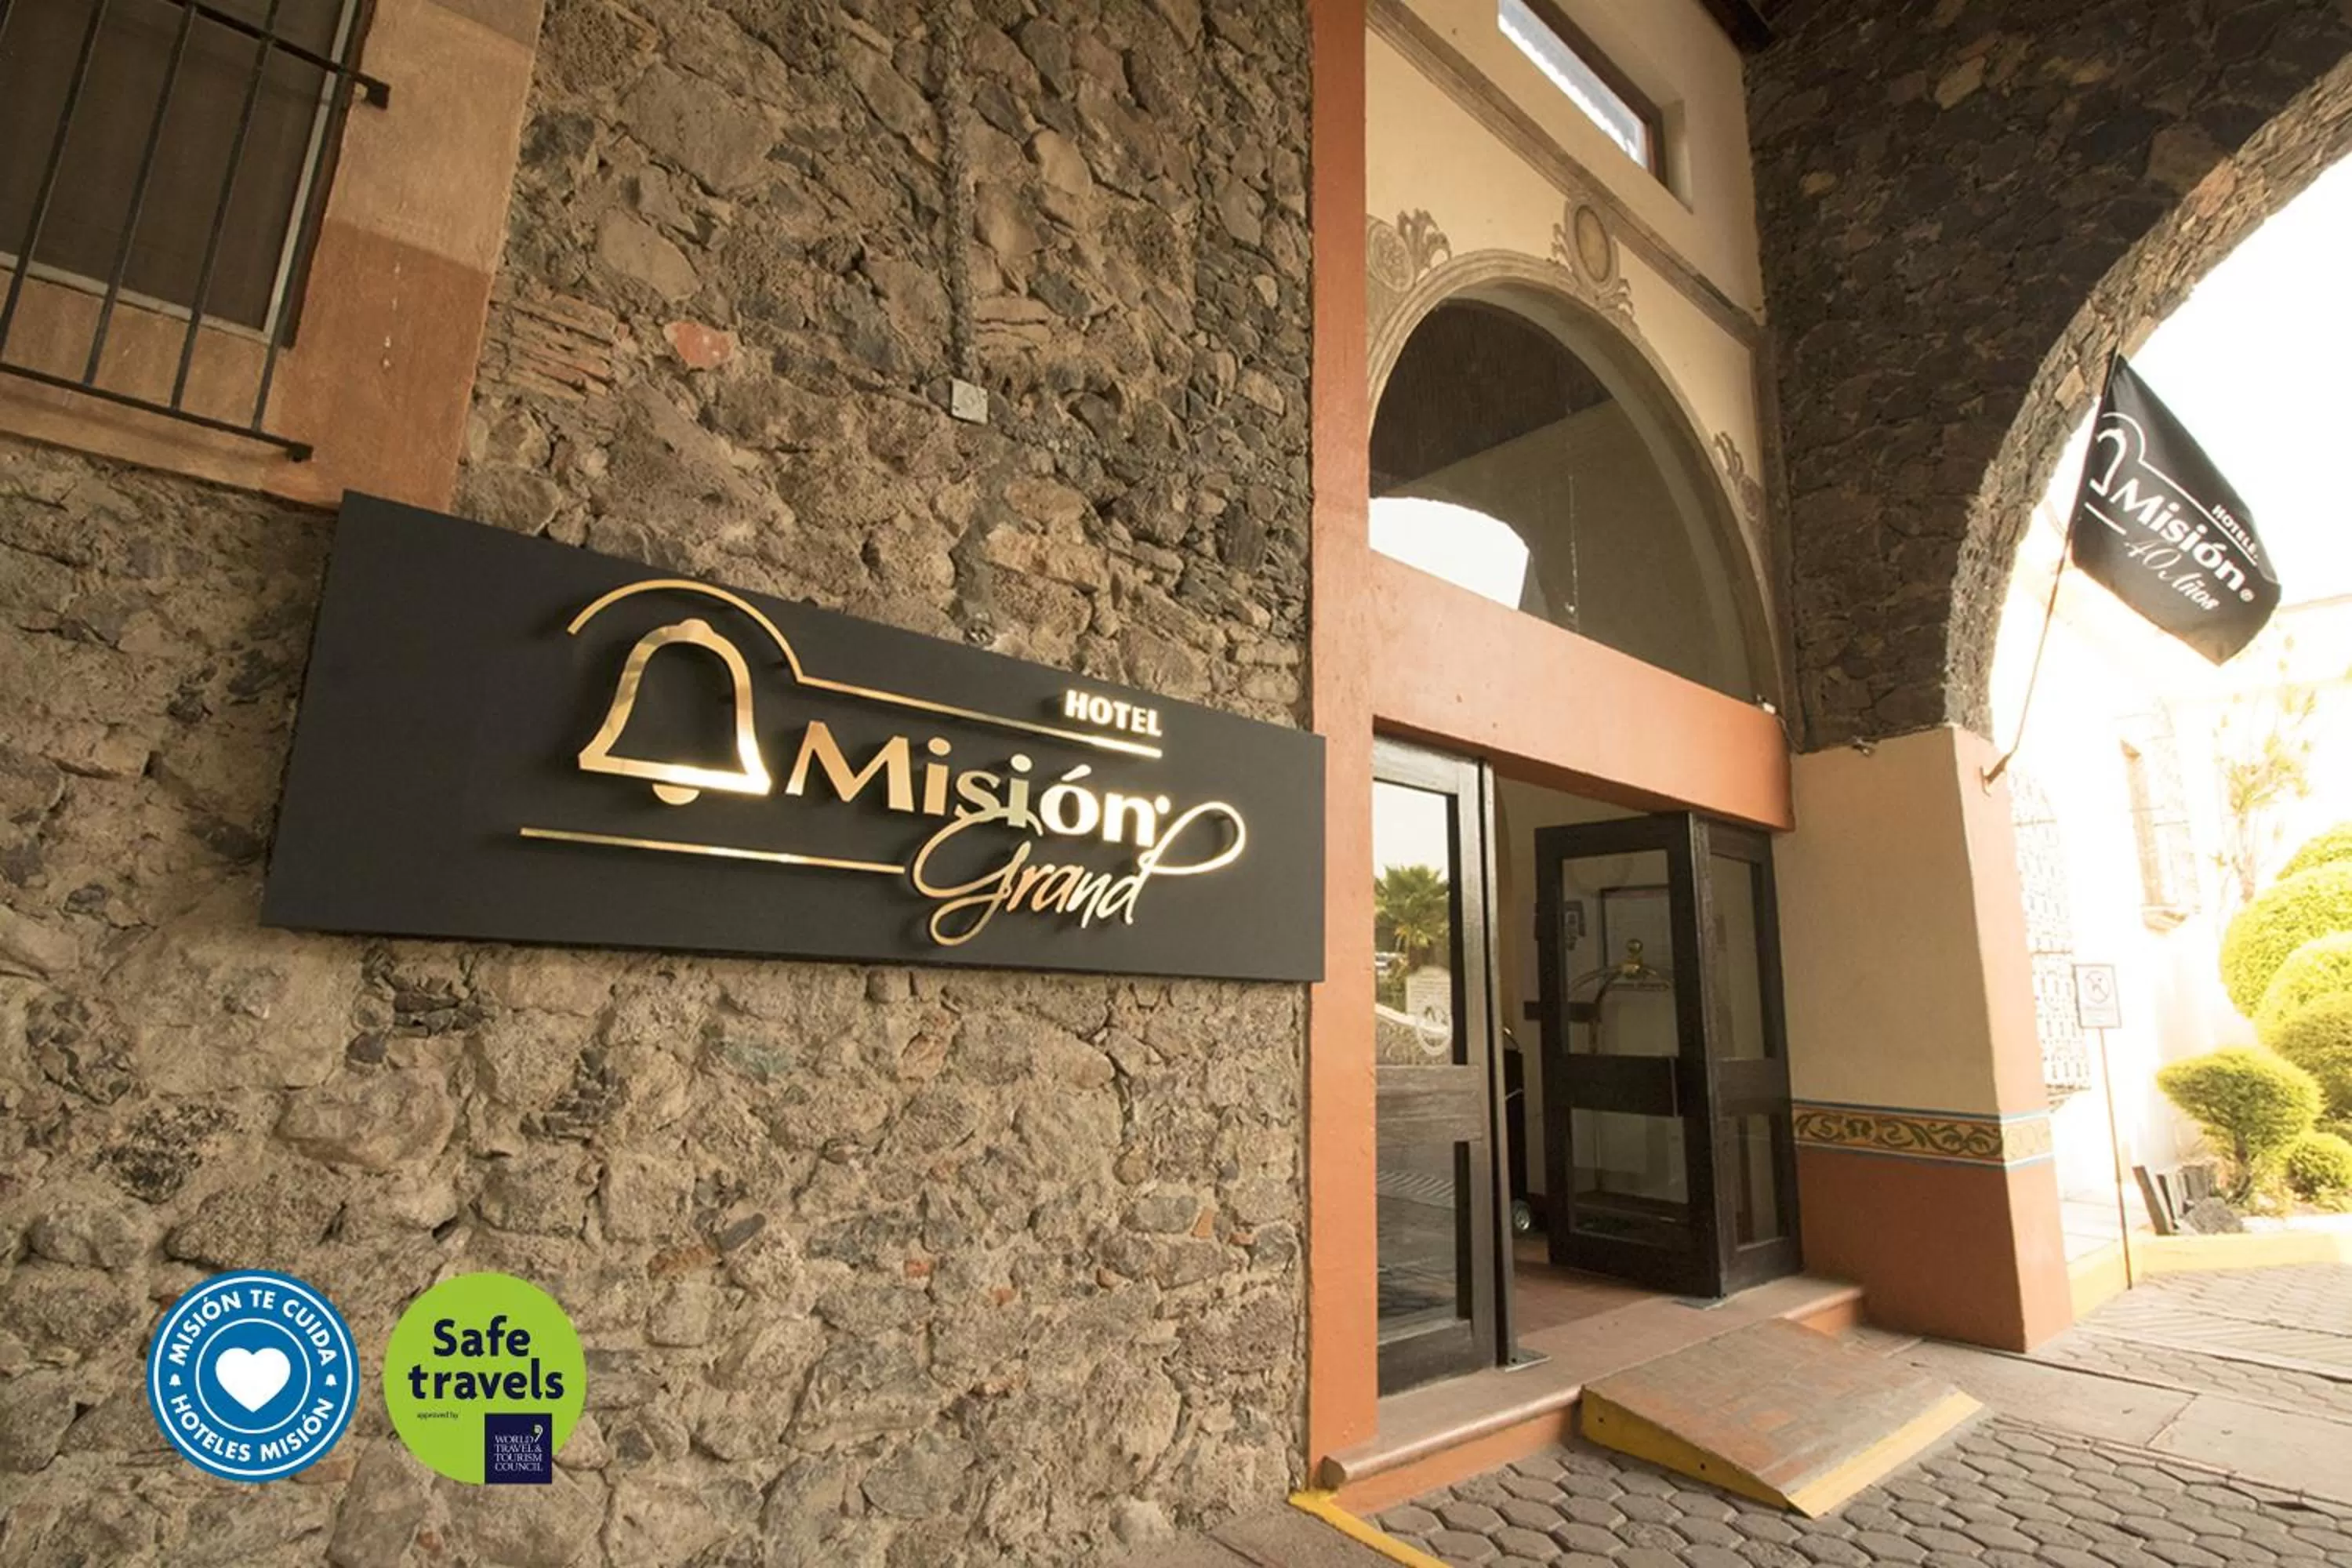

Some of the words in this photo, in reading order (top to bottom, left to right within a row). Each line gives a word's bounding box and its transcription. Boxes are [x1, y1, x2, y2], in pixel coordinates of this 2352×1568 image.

[2110, 478, 2246, 591] Misión
[1065, 689, 1163, 737] HOTEL
[786, 720, 1157, 848] Misión
[911, 800, 1247, 946] Grand
